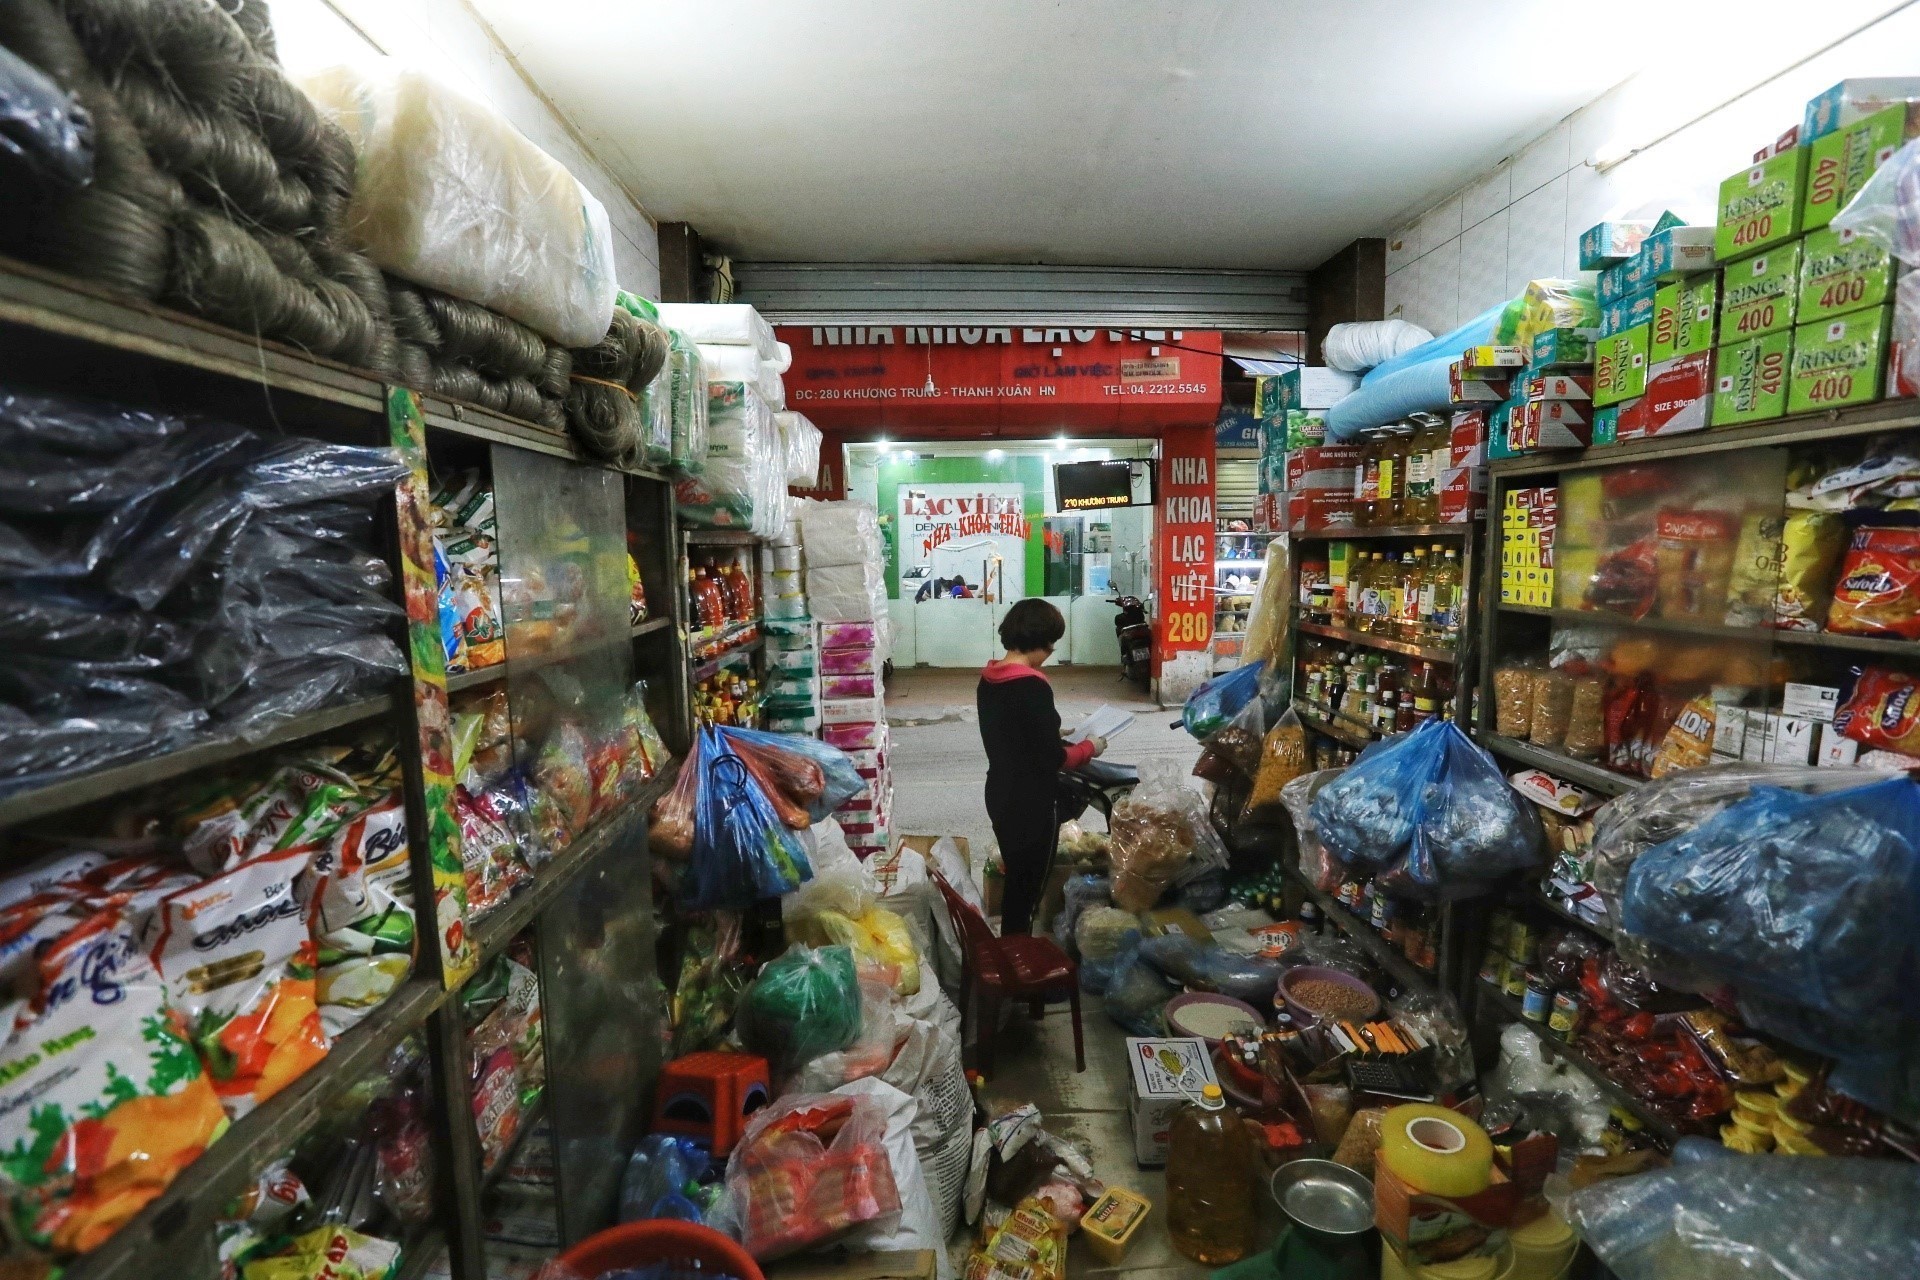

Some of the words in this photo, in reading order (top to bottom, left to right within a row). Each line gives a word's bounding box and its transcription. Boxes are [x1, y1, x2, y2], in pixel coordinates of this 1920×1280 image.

[1811, 159, 1838, 205] 400
[1733, 214, 1772, 246] 400
[1819, 277, 1865, 309] 400
[1655, 306, 1674, 345] 400
[1736, 304, 1775, 333] 400
[1597, 355, 1612, 389] 400
[1616, 338, 1629, 392] RINGO
[1736, 348, 1754, 413] RINGO
[1761, 352, 1784, 395] 400
[820, 390, 840, 399] 280
[843, 387, 897, 399] KHƯƠNG
[900, 387, 942, 398] TRUNG
[951, 387, 994, 397] THANH
[997, 384, 1032, 397] XUÂN
[1039, 386, 1056, 396] HN
[1654, 401, 1672, 413] SIZE
[1673, 398, 1697, 410] 30cm
[1808, 376, 1853, 403] 400
[1171, 458, 1209, 485] NHA
[903, 497, 953, 521] LẠC
[1166, 496, 1212, 523] KHOA
[923, 523, 951, 558] NHA
[958, 513, 992, 538] KHOA
[1172, 535, 1205, 567] LẠC
[1171, 569, 1208, 607] VIỆT
[1168, 612, 1208, 642] 280
